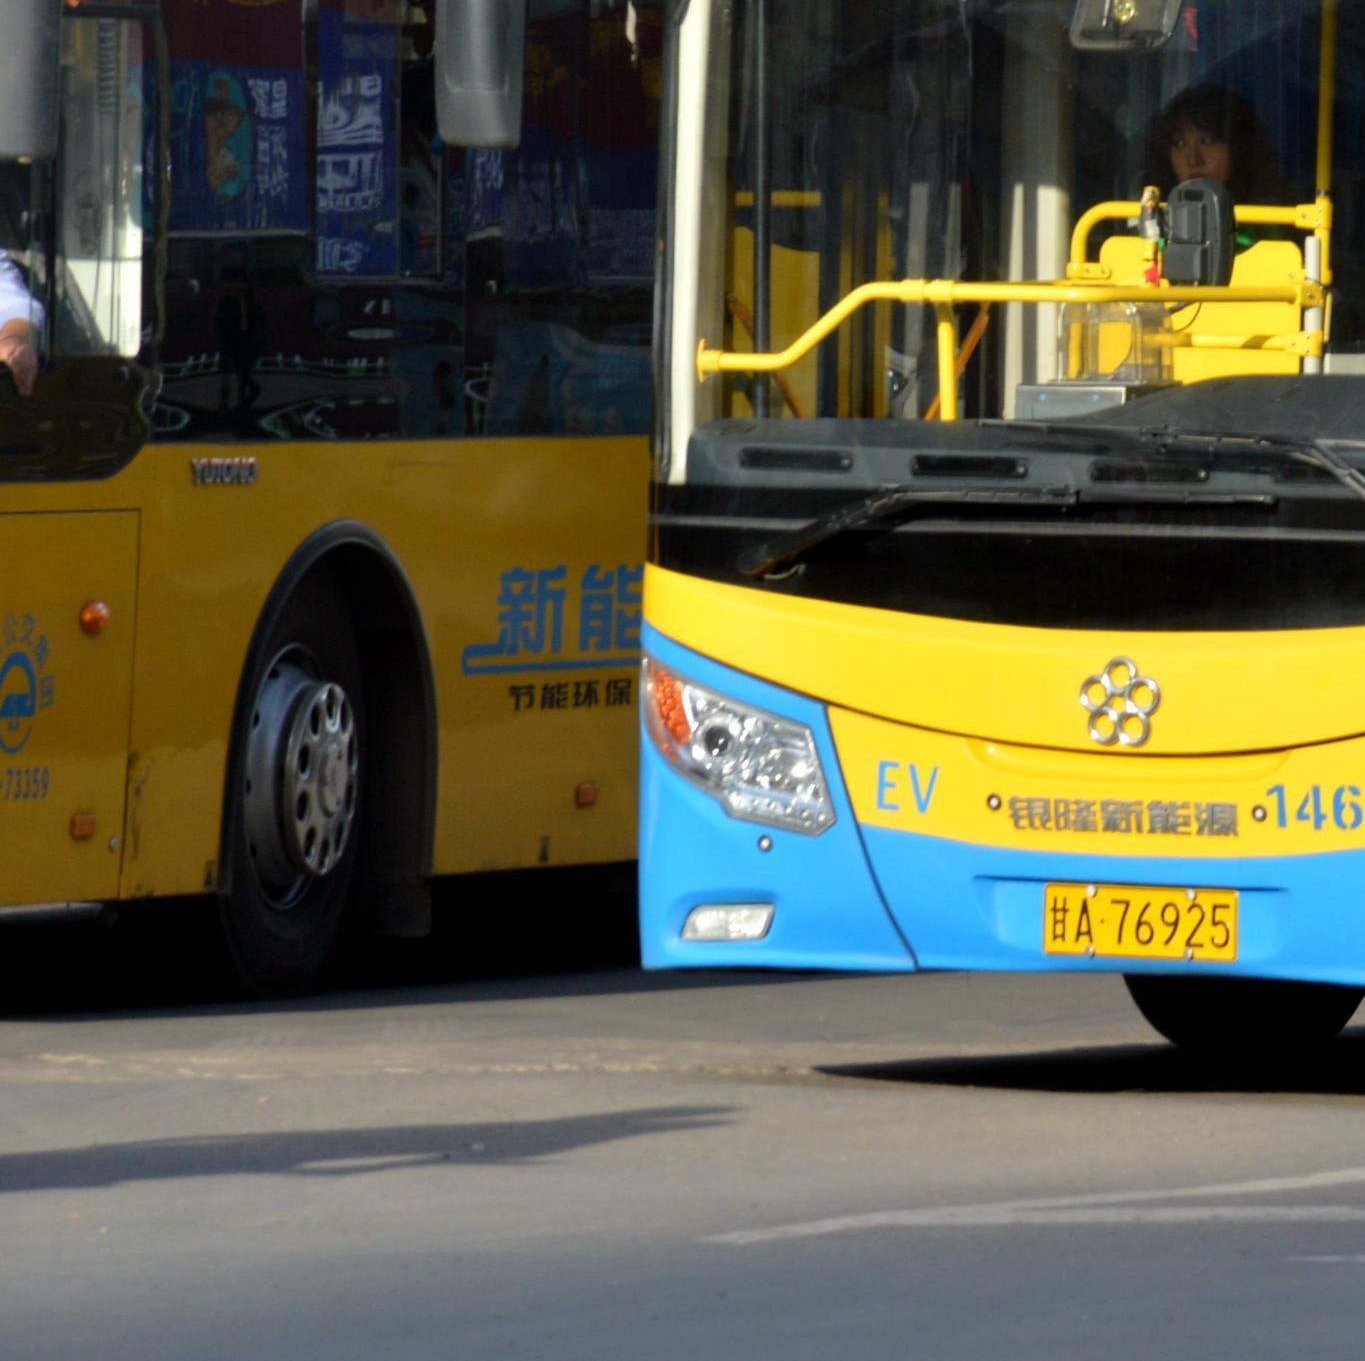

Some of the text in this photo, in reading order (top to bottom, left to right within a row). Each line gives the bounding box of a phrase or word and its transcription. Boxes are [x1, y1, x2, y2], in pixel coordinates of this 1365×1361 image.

[508, 678, 633, 712] 节能环保
[876, 760, 940, 814] EV
[1008, 796, 1239, 836] 银隆新能源
